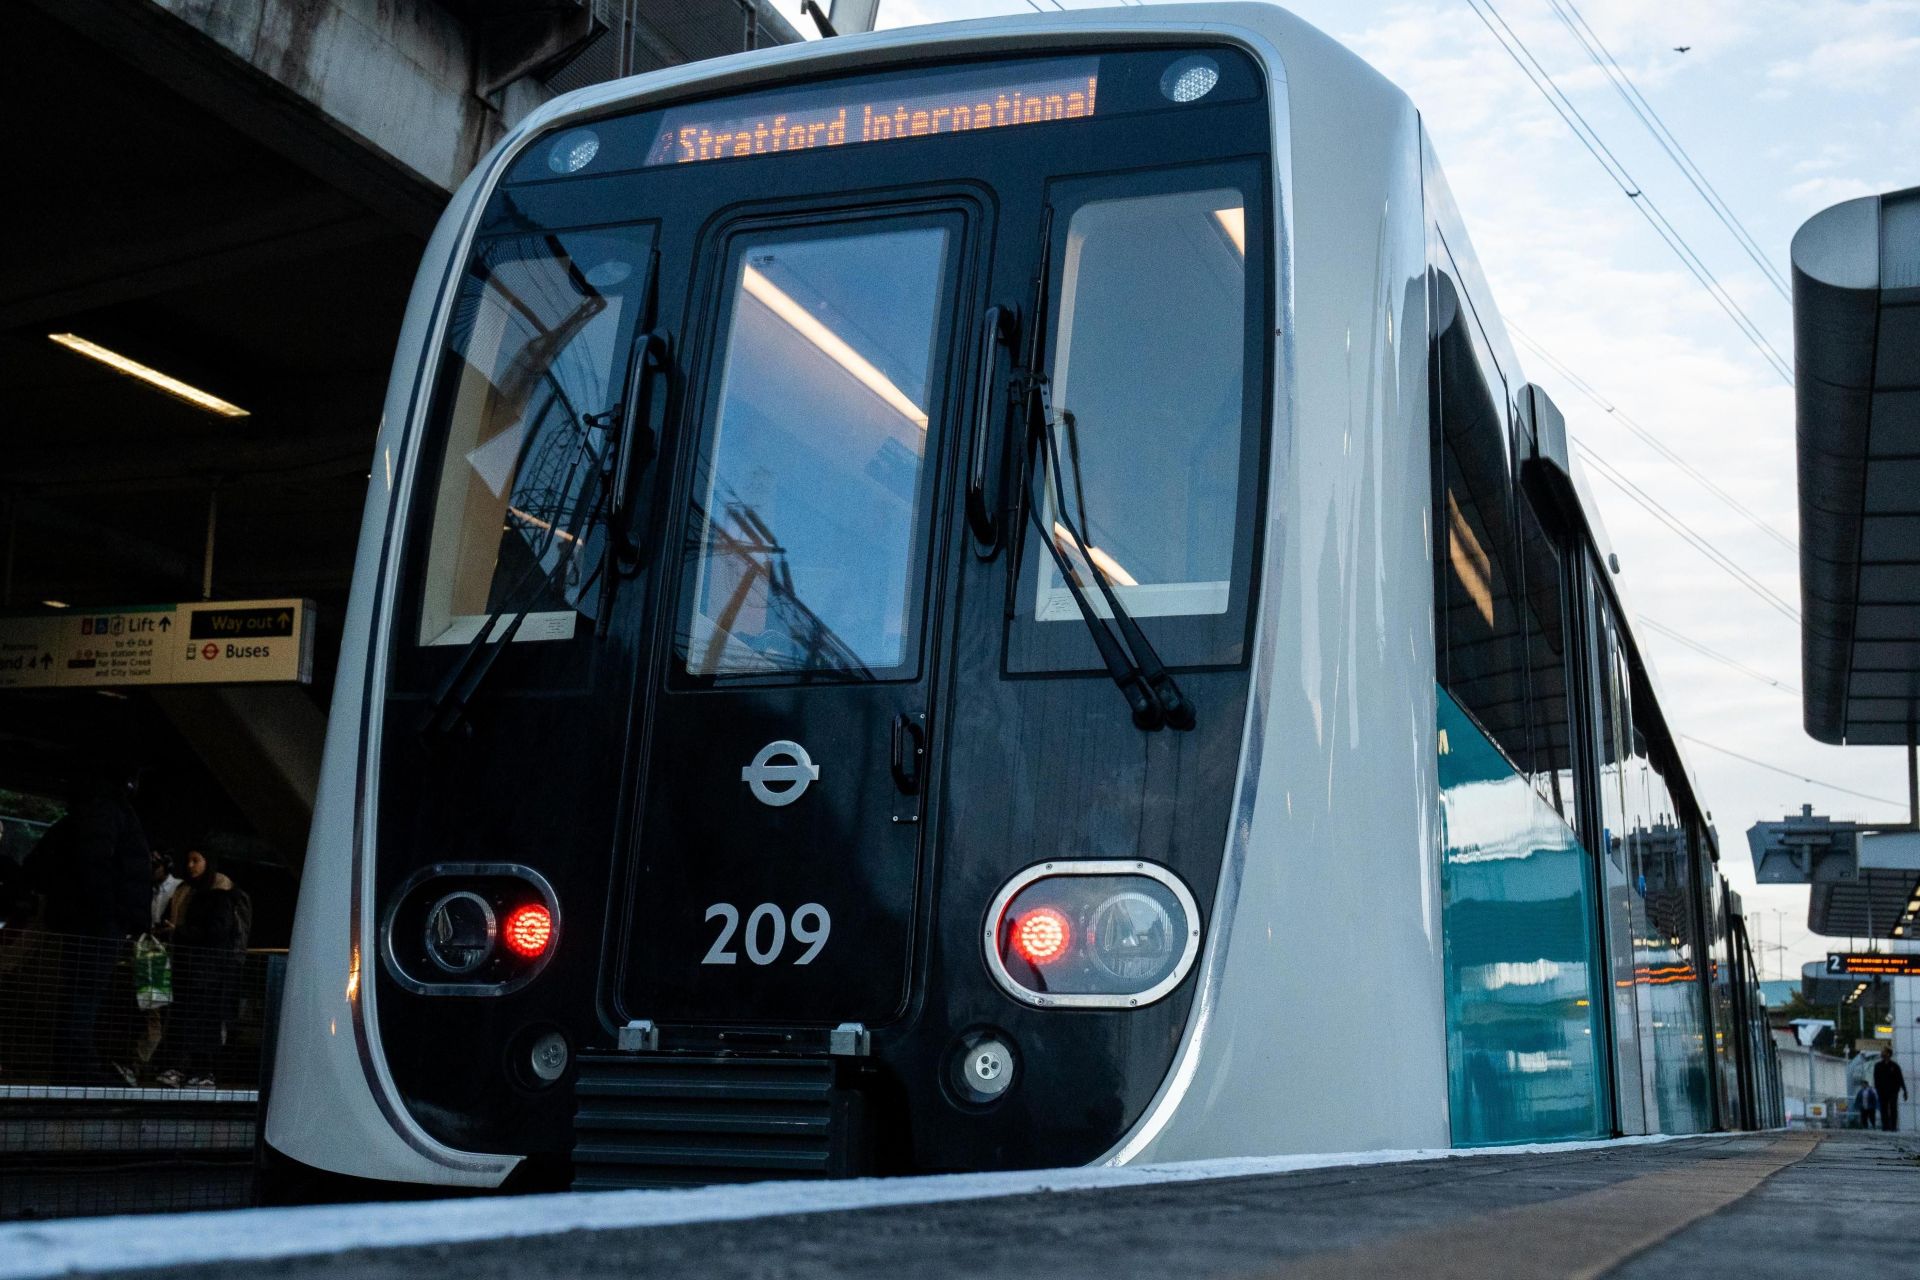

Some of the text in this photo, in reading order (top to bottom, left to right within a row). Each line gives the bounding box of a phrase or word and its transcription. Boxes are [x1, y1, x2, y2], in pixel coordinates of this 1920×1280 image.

[677, 75, 1097, 163] Stratford International
[128, 616, 155, 633] Lift
[211, 615, 273, 632] Way out
[226, 644, 270, 658] Buses
[28, 655, 36, 668] 4
[701, 902, 831, 966] 209
[1830, 955, 1840, 970] 2
